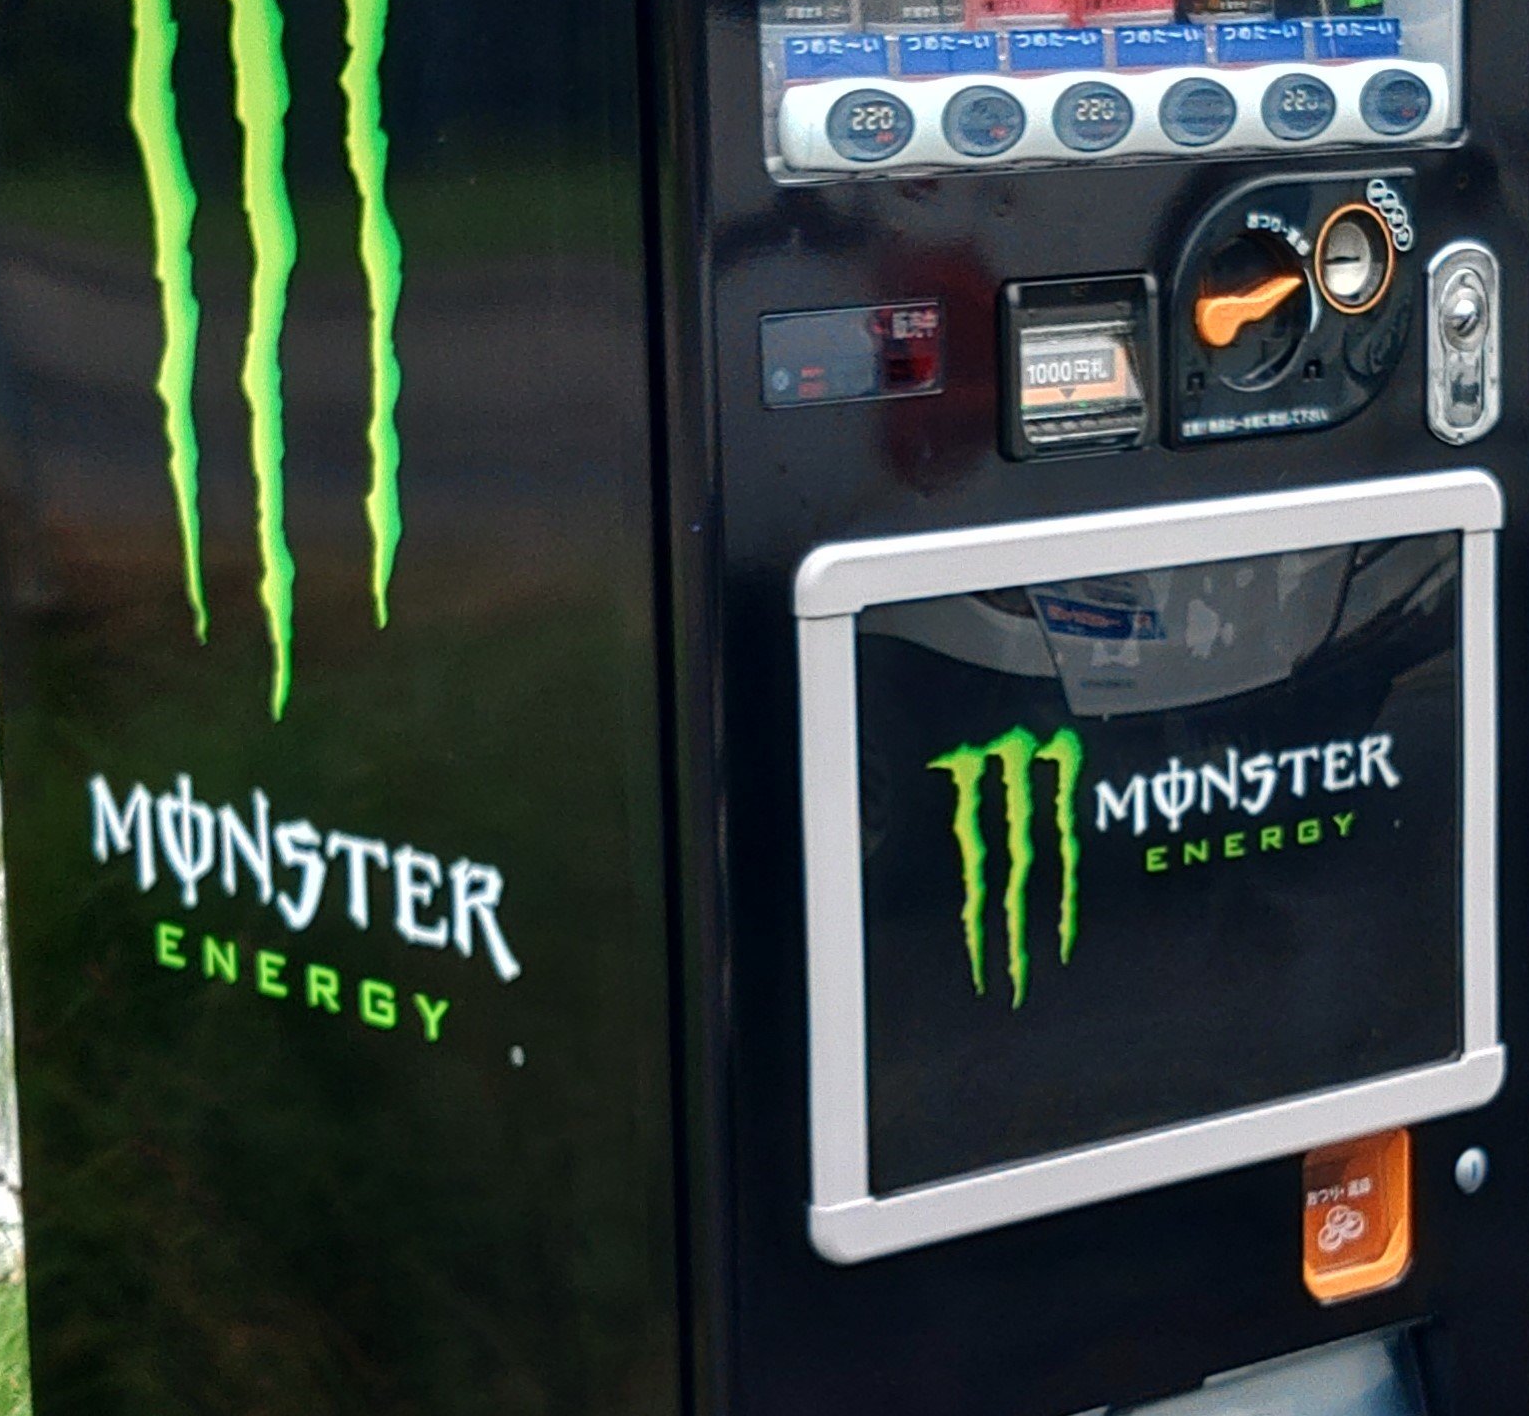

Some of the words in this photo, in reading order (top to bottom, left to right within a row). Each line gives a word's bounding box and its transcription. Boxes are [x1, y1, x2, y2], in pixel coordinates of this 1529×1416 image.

[851, 106, 894, 131] 220
[1026, 357, 1108, 385] 1000円札
[1094, 732, 1400, 836] MONSTER
[88, 772, 521, 982] MONSTER
[1145, 812, 1355, 872] ENERGY
[154, 922, 450, 1041] ENERGY
